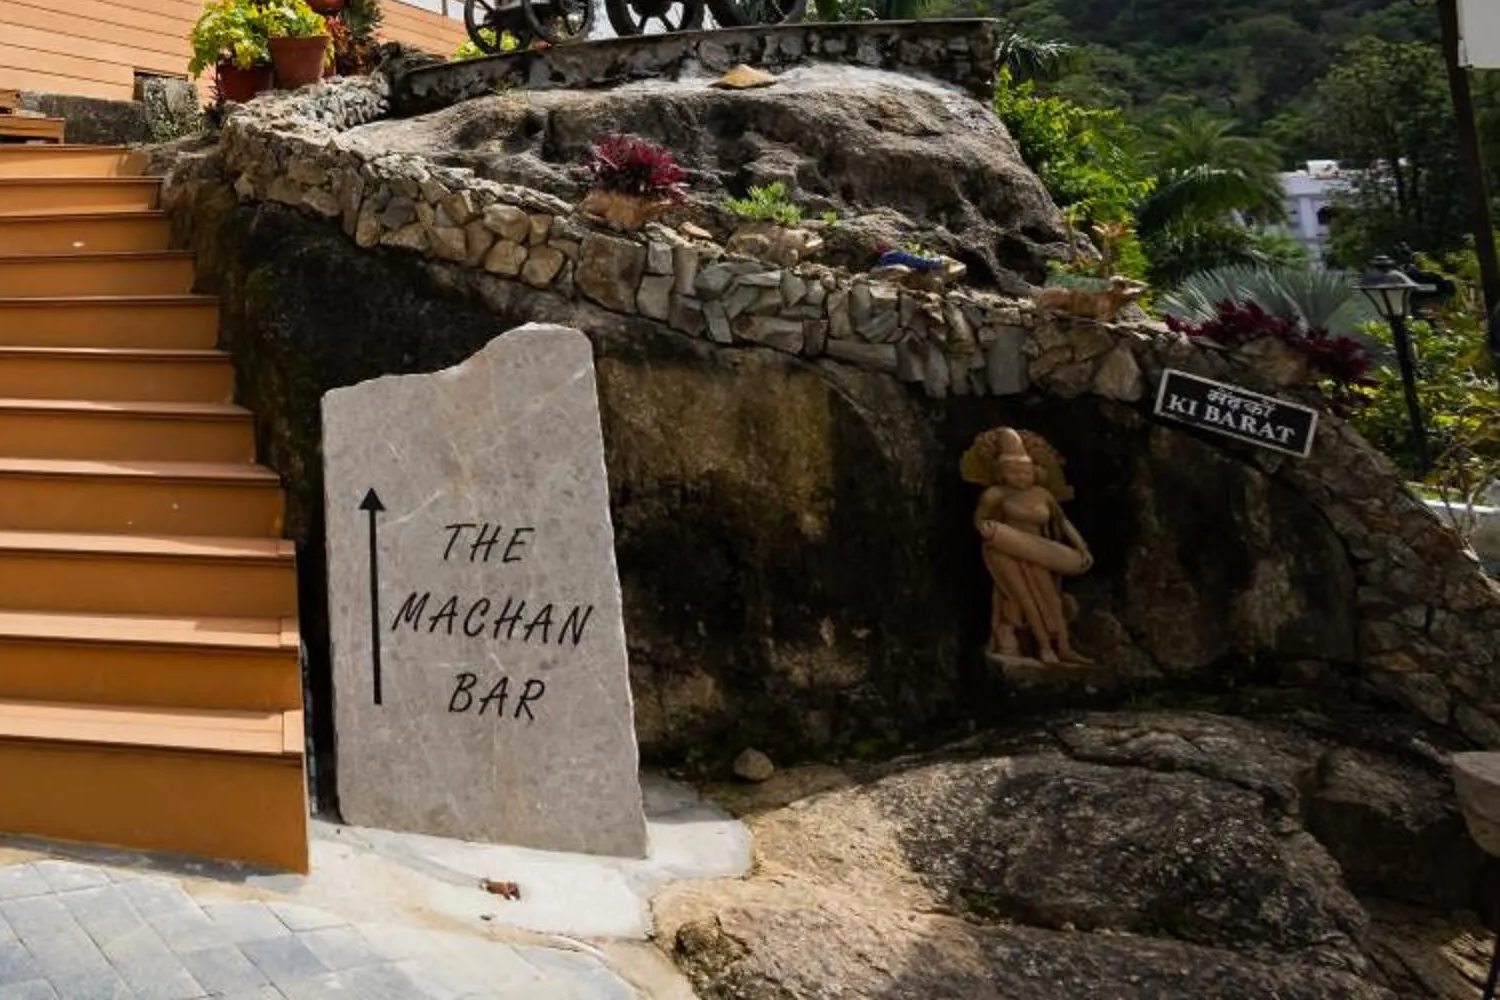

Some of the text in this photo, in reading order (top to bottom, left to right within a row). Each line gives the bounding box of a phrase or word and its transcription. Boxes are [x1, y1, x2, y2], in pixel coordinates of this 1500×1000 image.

[1166, 393, 1296, 444] KI BARAT
[443, 522, 535, 563] THE
[391, 591, 594, 648] MACHAN
[447, 672, 546, 723] BAR
